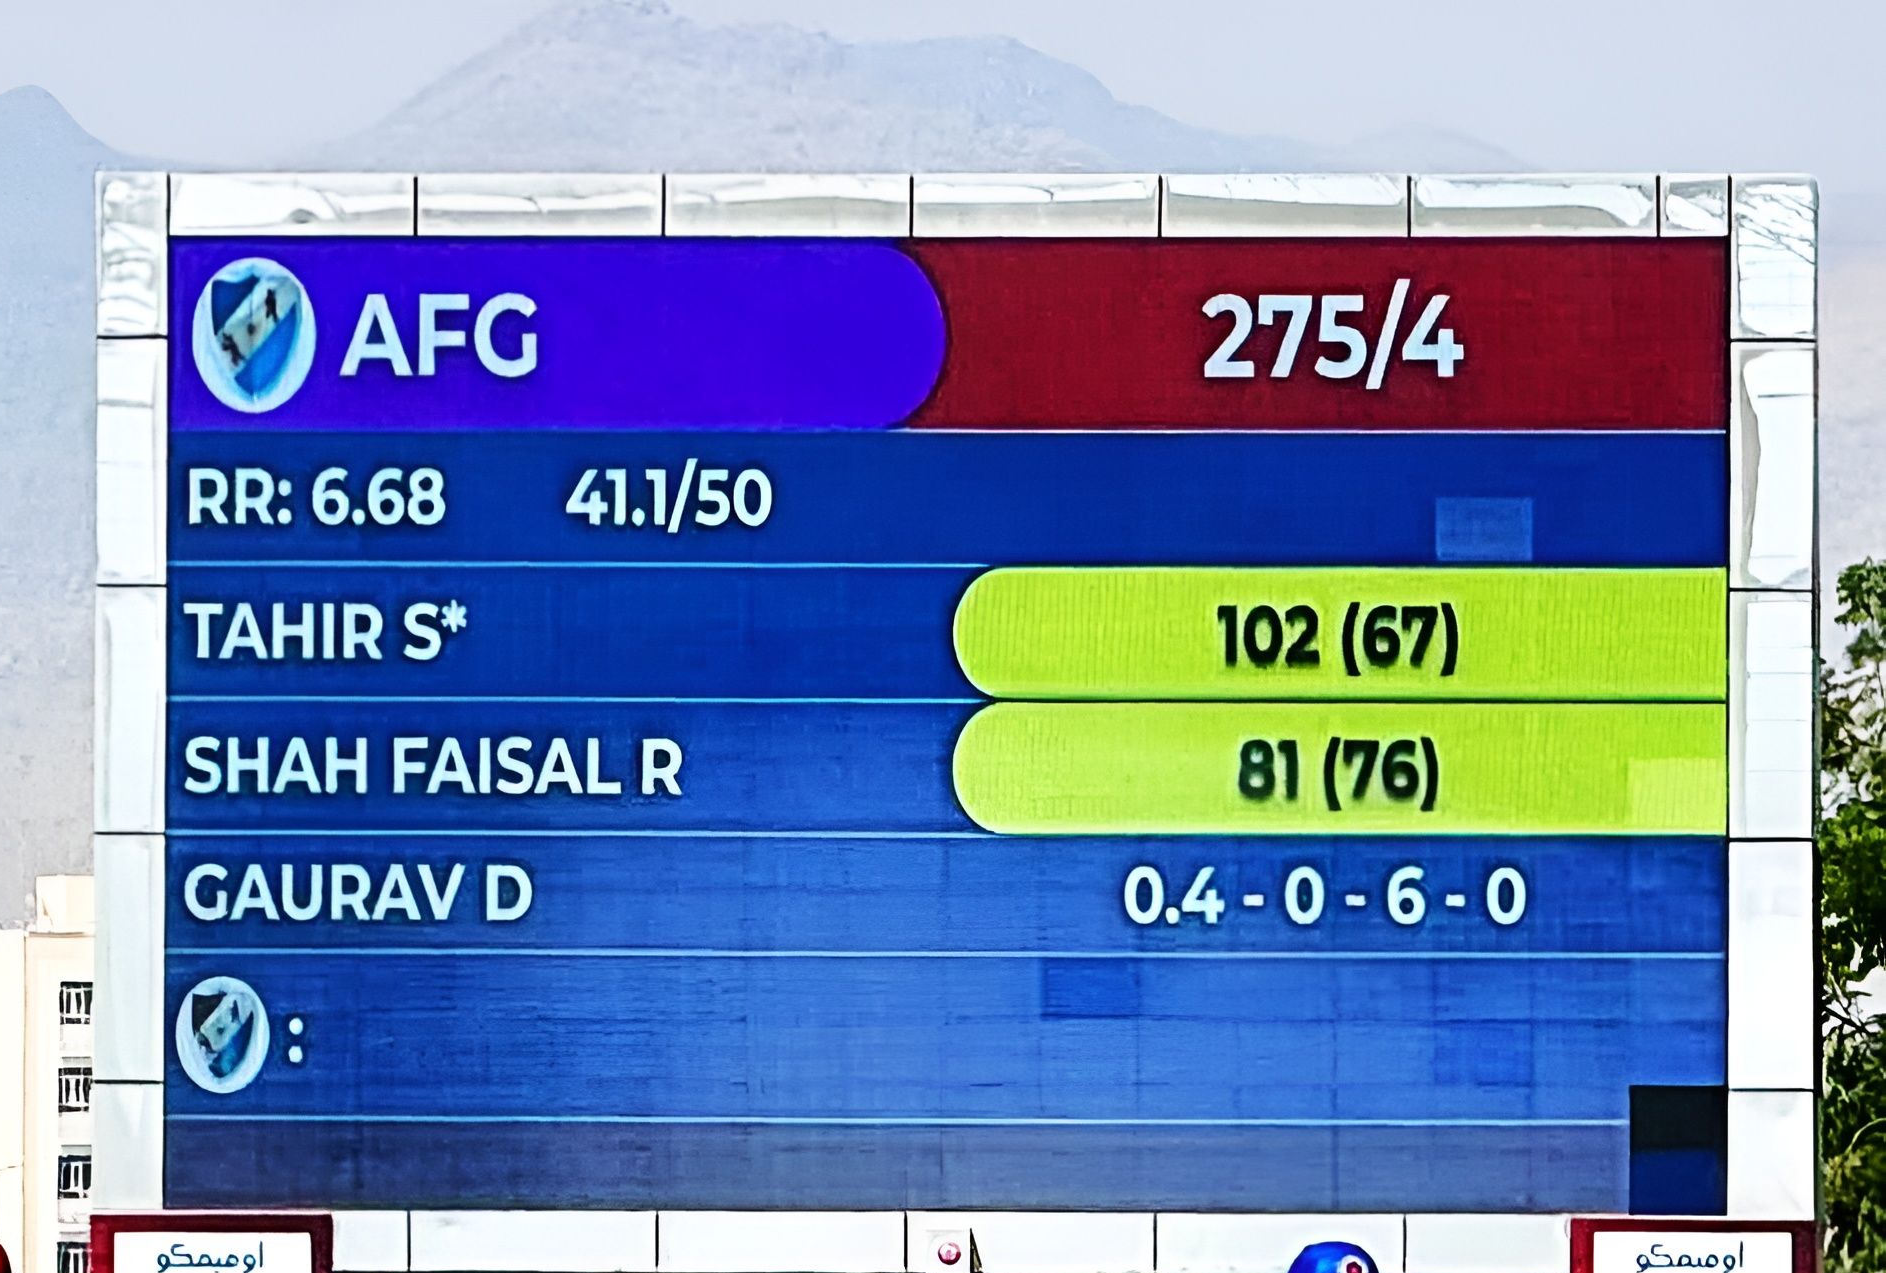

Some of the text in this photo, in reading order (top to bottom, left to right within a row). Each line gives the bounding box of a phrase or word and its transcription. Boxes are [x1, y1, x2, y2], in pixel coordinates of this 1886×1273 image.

[338, 291, 540, 379] AFG
[1200, 277, 1466, 391] 275/4
[187, 466, 447, 526] RR: 6.68
[564, 457, 774, 534] 41.1/50
[182, 601, 384, 661] TAHIR
[1215, 600, 1460, 678] 102 (67)
[183, 735, 684, 796] SHAH FAISAL R
[1237, 735, 1440, 813] 81 (76)
[183, 862, 534, 922] GAURAV D
[1123, 865, 1226, 926] 0.4
[1283, 865, 1325, 926] 0
[1386, 865, 1427, 926] 6
[1485, 866, 1527, 926] 0
